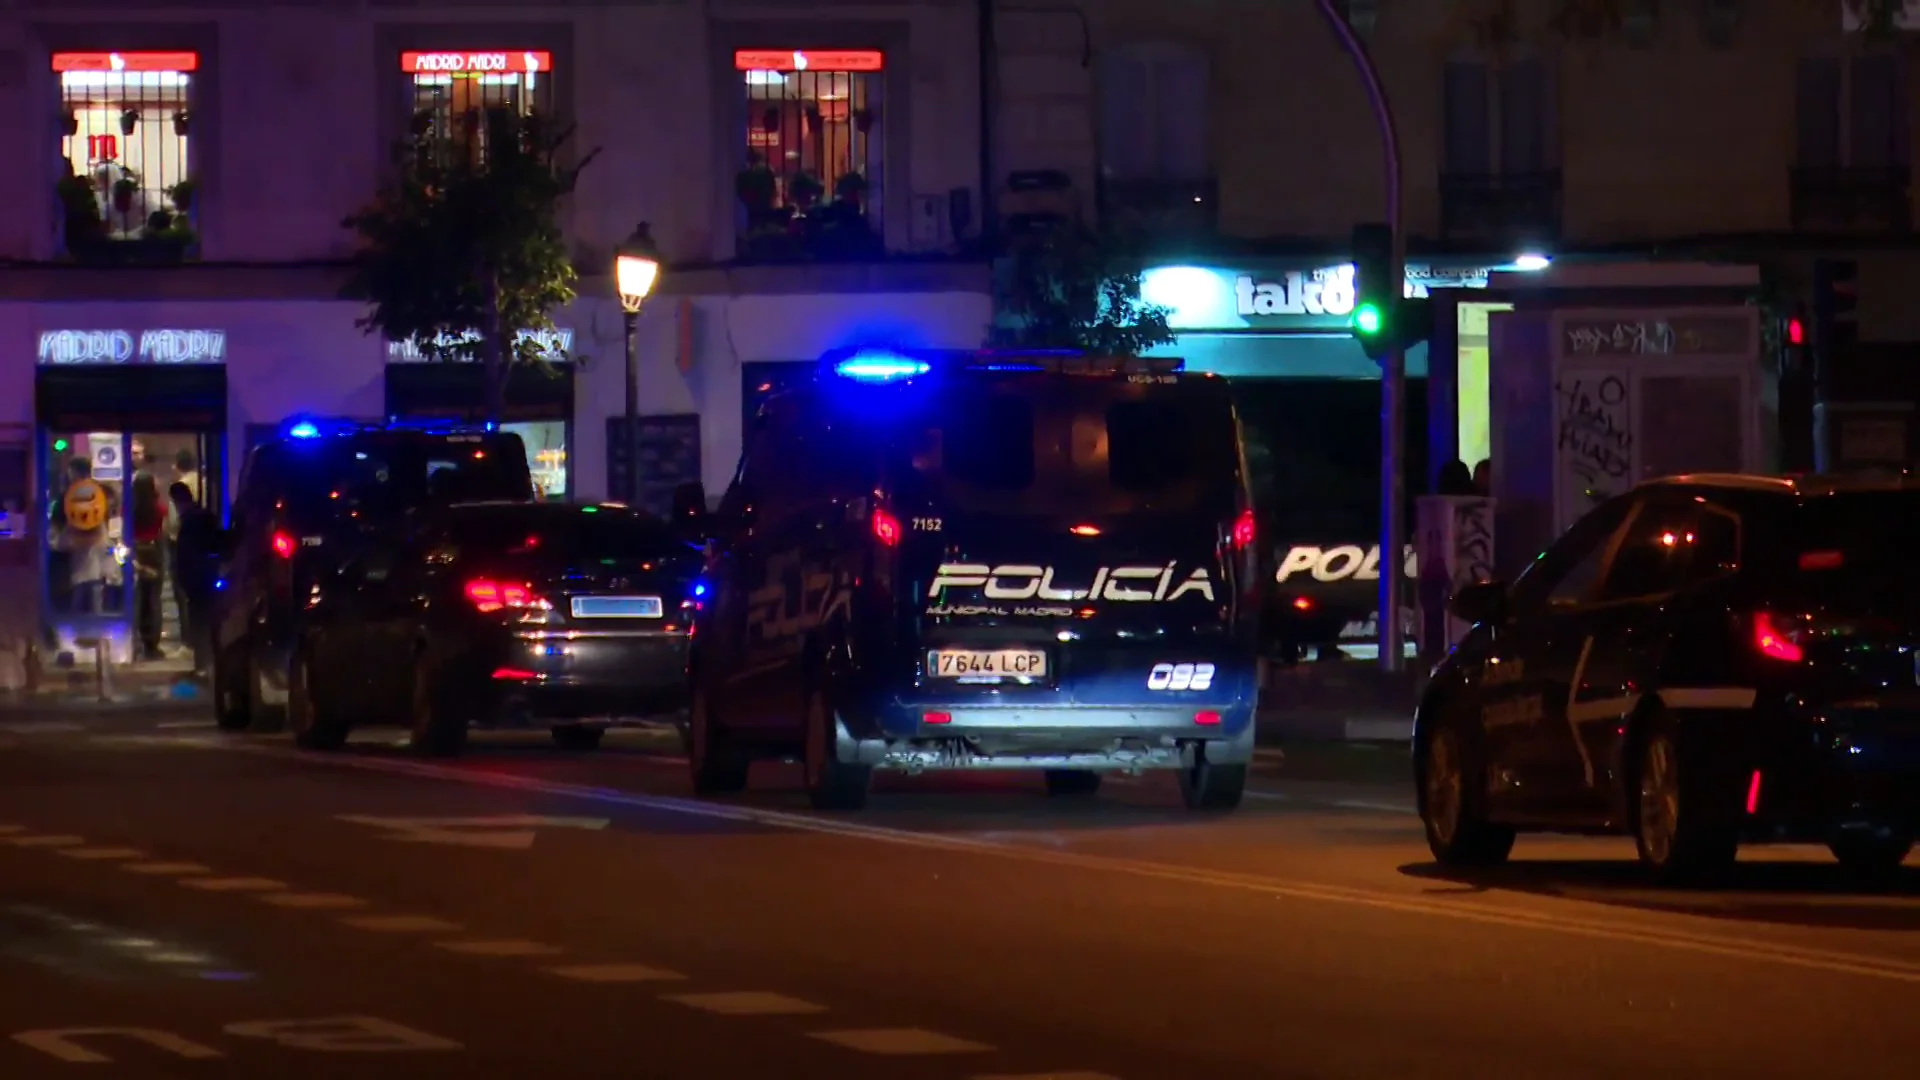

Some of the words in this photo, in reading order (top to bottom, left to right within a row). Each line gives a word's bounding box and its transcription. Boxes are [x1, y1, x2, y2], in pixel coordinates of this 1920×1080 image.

[415, 55, 464, 70] MADRID
[39, 330, 135, 364] MADRID
[912, 516, 943, 532] 7152
[928, 560, 1215, 601] POLICÍA
[942, 654, 994, 673] 7644
[1001, 654, 1041, 672] LCP
[1148, 663, 1215, 690] 092
